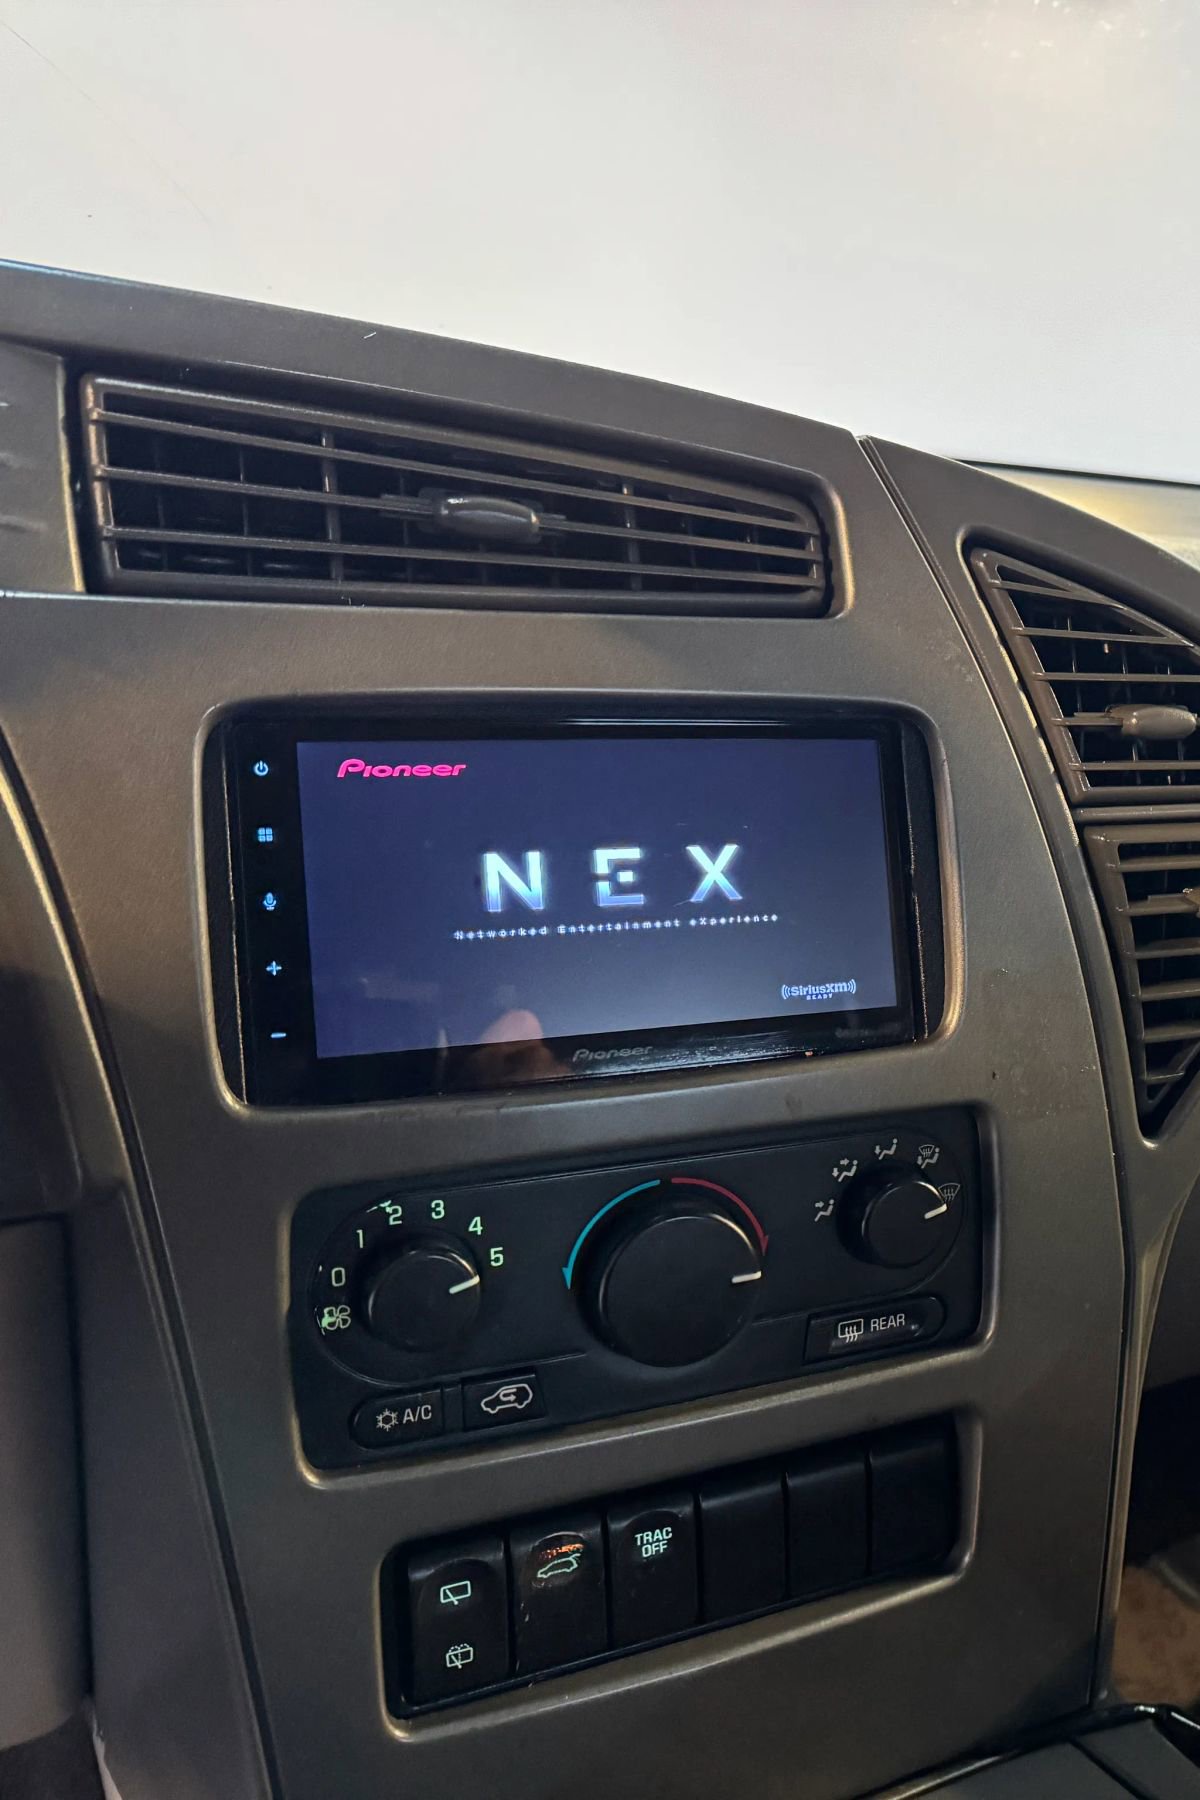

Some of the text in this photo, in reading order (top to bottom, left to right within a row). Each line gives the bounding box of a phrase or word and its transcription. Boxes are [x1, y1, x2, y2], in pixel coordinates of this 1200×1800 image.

[337, 758, 467, 778] Pioneer
[454, 927, 548, 940] Networked
[557, 918, 681, 935] Entertainment
[572, 1046, 653, 1062] Pioneer
[388, 1205, 403, 1225] 2
[431, 1200, 445, 1219] 3
[468, 1216, 483, 1235] 4
[356, 1229, 364, 1249] 1
[490, 1247, 504, 1267] 5
[331, 1267, 346, 1287] 0
[870, 1313, 905, 1332] REAR
[402, 1404, 432, 1424] A/C
[634, 1526, 673, 1546] TRAC
[641, 1540, 668, 1558] OFF
